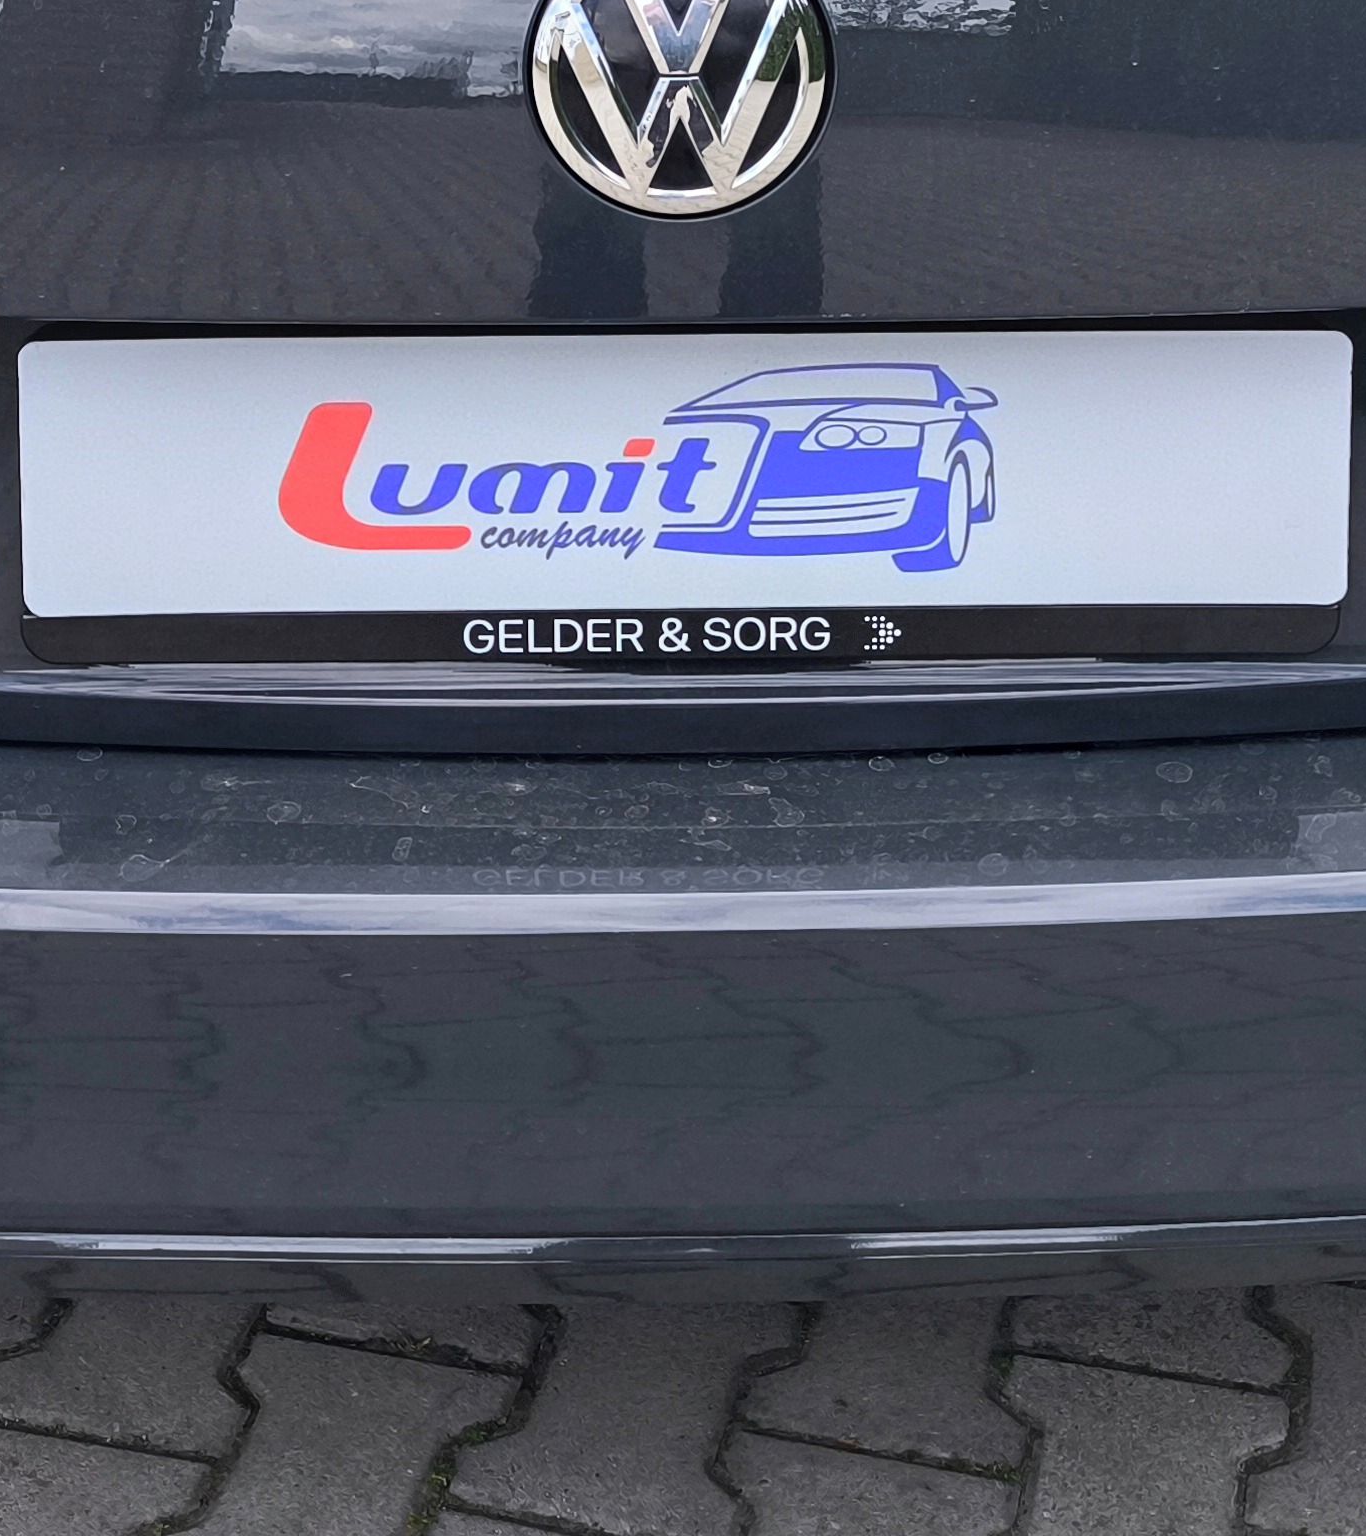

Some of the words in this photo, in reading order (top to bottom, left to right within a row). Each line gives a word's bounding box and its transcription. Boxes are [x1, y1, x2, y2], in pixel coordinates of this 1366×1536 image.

[278, 402, 717, 551] Lumit
[479, 521, 648, 561] company
[462, 617, 645, 655] GELDER
[657, 617, 692, 653] &
[702, 615, 832, 653] SORG
